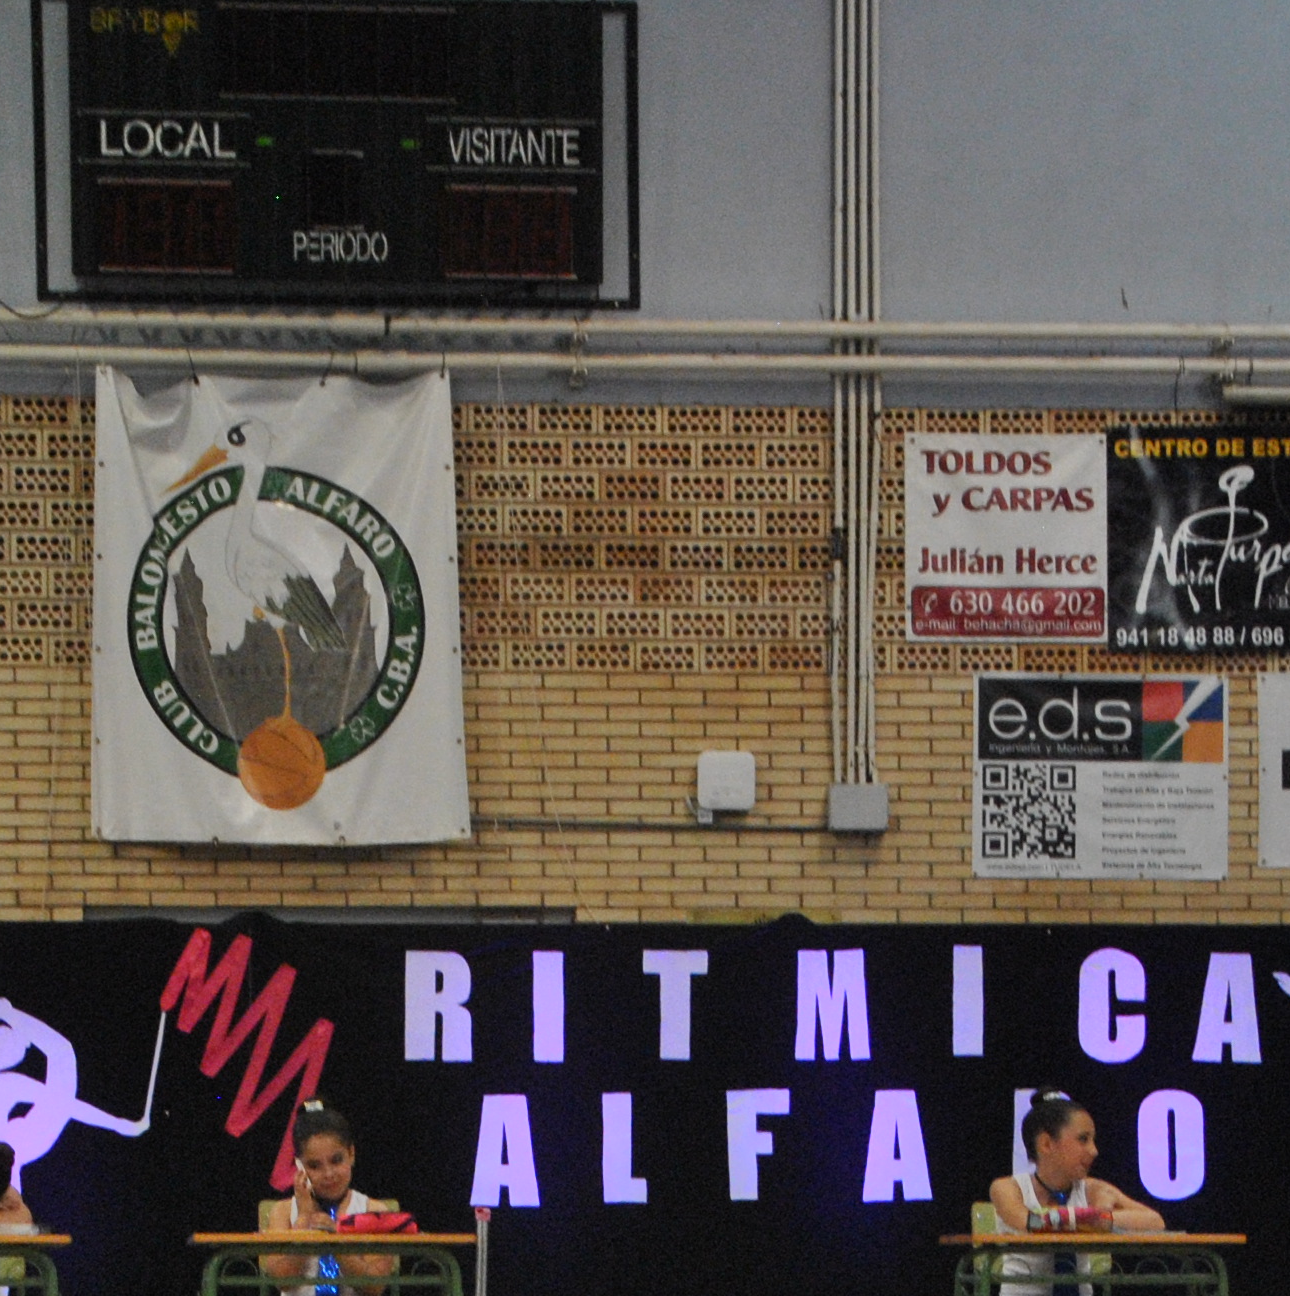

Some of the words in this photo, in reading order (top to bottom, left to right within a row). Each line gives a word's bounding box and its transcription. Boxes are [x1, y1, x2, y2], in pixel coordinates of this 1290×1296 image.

[99, 119, 236, 160] LOCAL
[449, 128, 581, 166] VISITANTE
[293, 231, 389, 263] PERIODO
[1114, 437, 1208, 459] CENTRO
[1215, 437, 1245, 458] DE
[920, 450, 1052, 476] TOLDOS
[931, 491, 953, 517] y
[961, 487, 1095, 512] CARPAS
[917, 547, 1004, 575] Julián
[1015, 547, 1098, 575] Herce
[153, 681, 219, 754] CLUB
[285, 476, 396, 559] ALFARO
[377, 625, 418, 709] C.B.A.
[950, 591, 994, 616] 630
[1001, 591, 1045, 616] 466
[1054, 591, 1096, 616] 202
[915, 618, 956, 631] e-mail
[1116, 627, 1149, 647] 941
[1157, 627, 1179, 647] 18
[1184, 627, 1207, 647] 48
[1213, 627, 1235, 647] 88
[1239, 627, 1246, 646] /
[1251, 627, 1284, 647] 696
[404, 945, 1262, 1064] RITMICA
